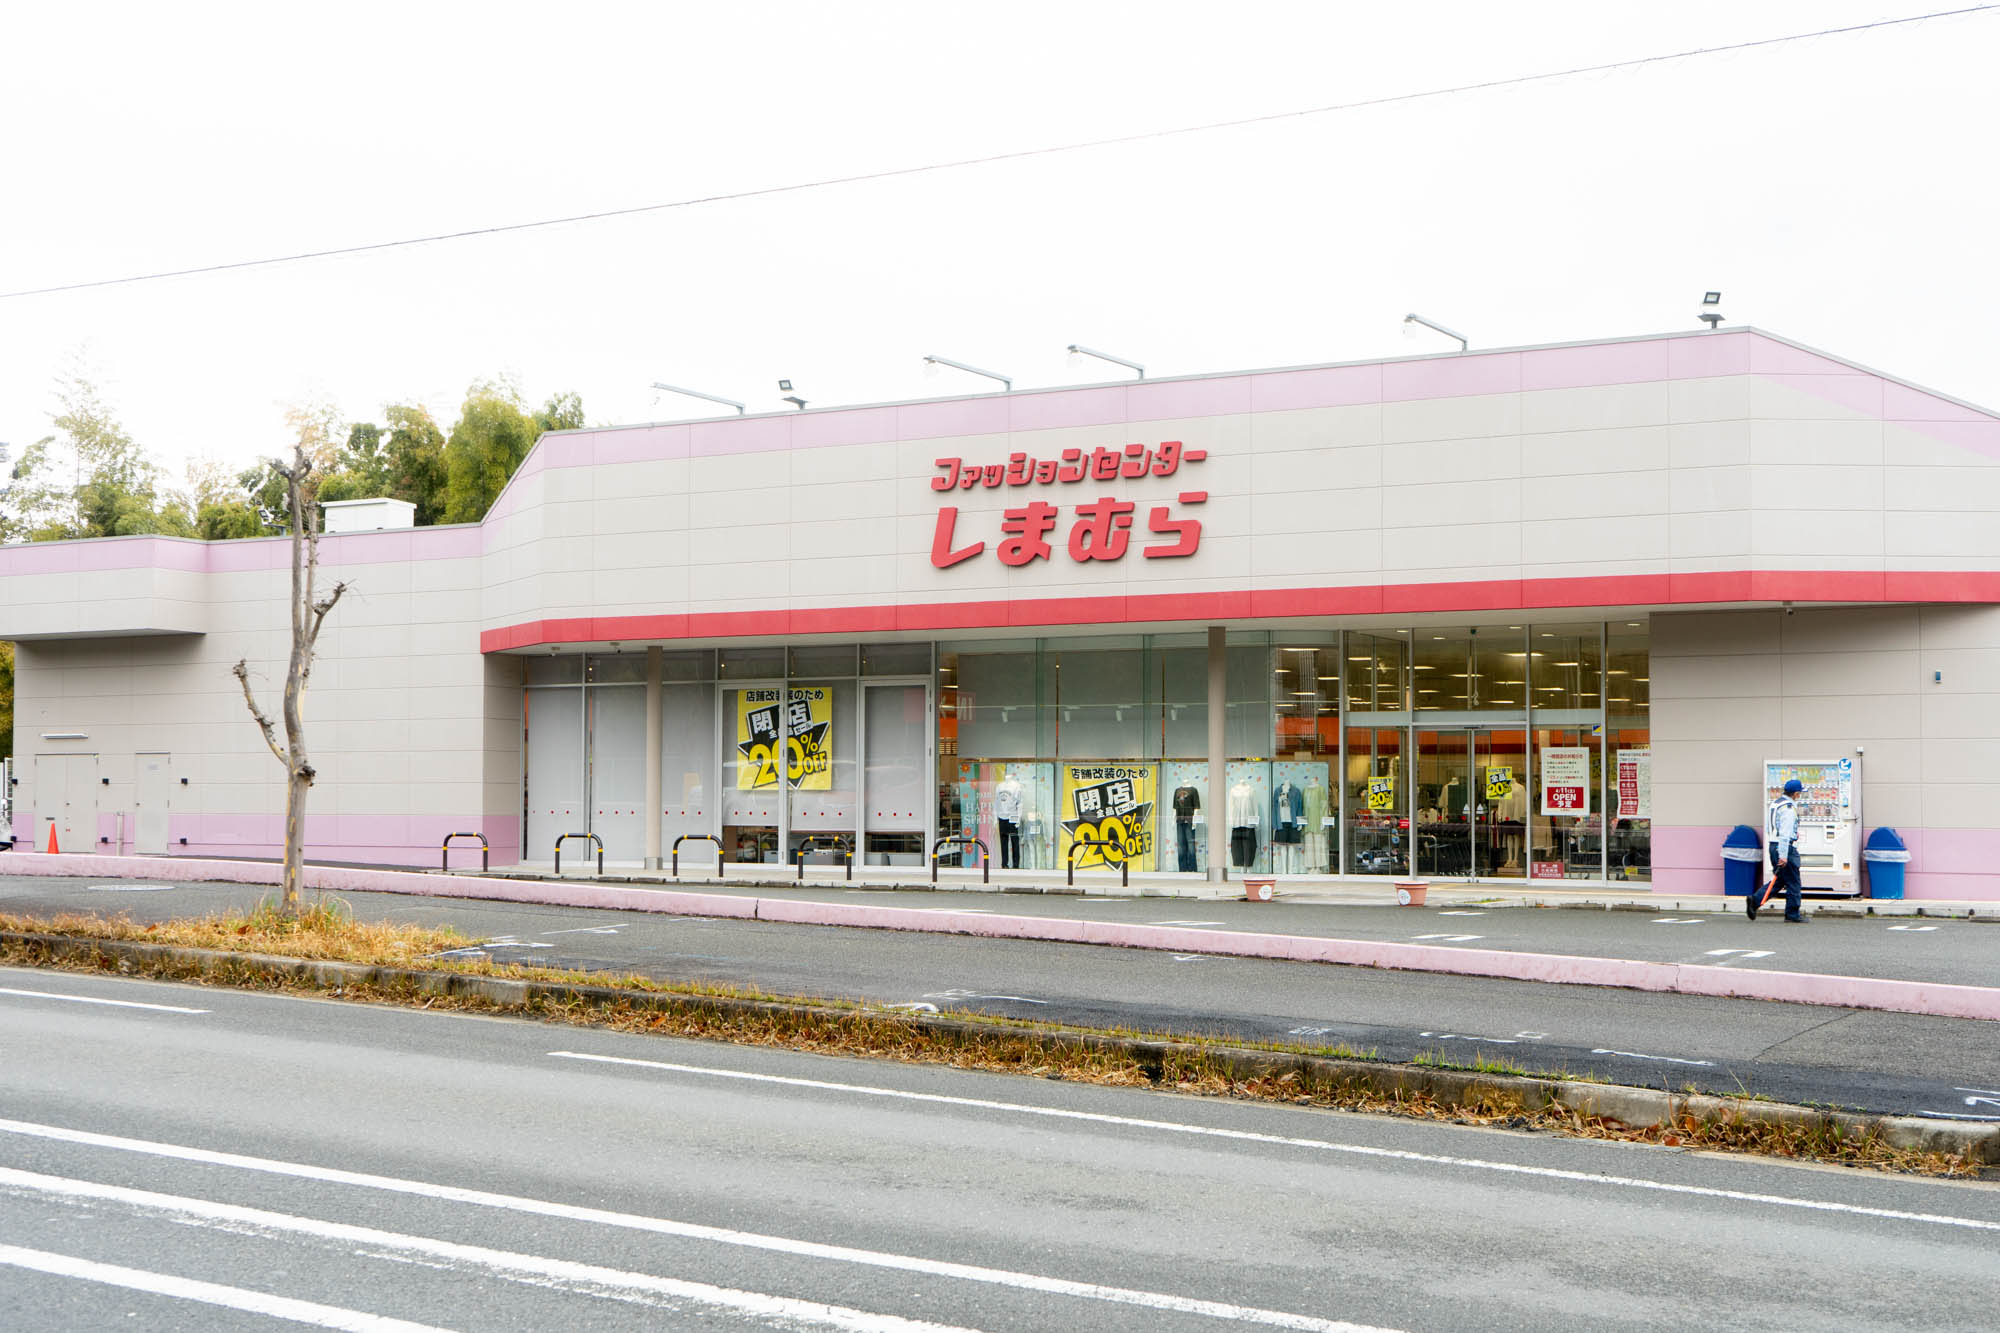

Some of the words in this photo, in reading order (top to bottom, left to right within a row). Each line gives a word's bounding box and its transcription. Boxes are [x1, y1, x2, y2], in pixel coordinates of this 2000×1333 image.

[930, 440, 1208, 492] ファッションセンター
[930, 491, 1209, 569] しまむら
[795, 723, 813, 734] セール
[803, 751, 828, 775] OFF
[1070, 767, 1149, 780] 店舗改装のため
[1079, 781, 1131, 813] 閉店
[1552, 793, 1577, 801] OPEN
[1117, 803, 1135, 814] セール
[1557, 800, 1573, 808] 予定
[1096, 806, 1115, 819] 全品
[1125, 831, 1152, 857] OFF
